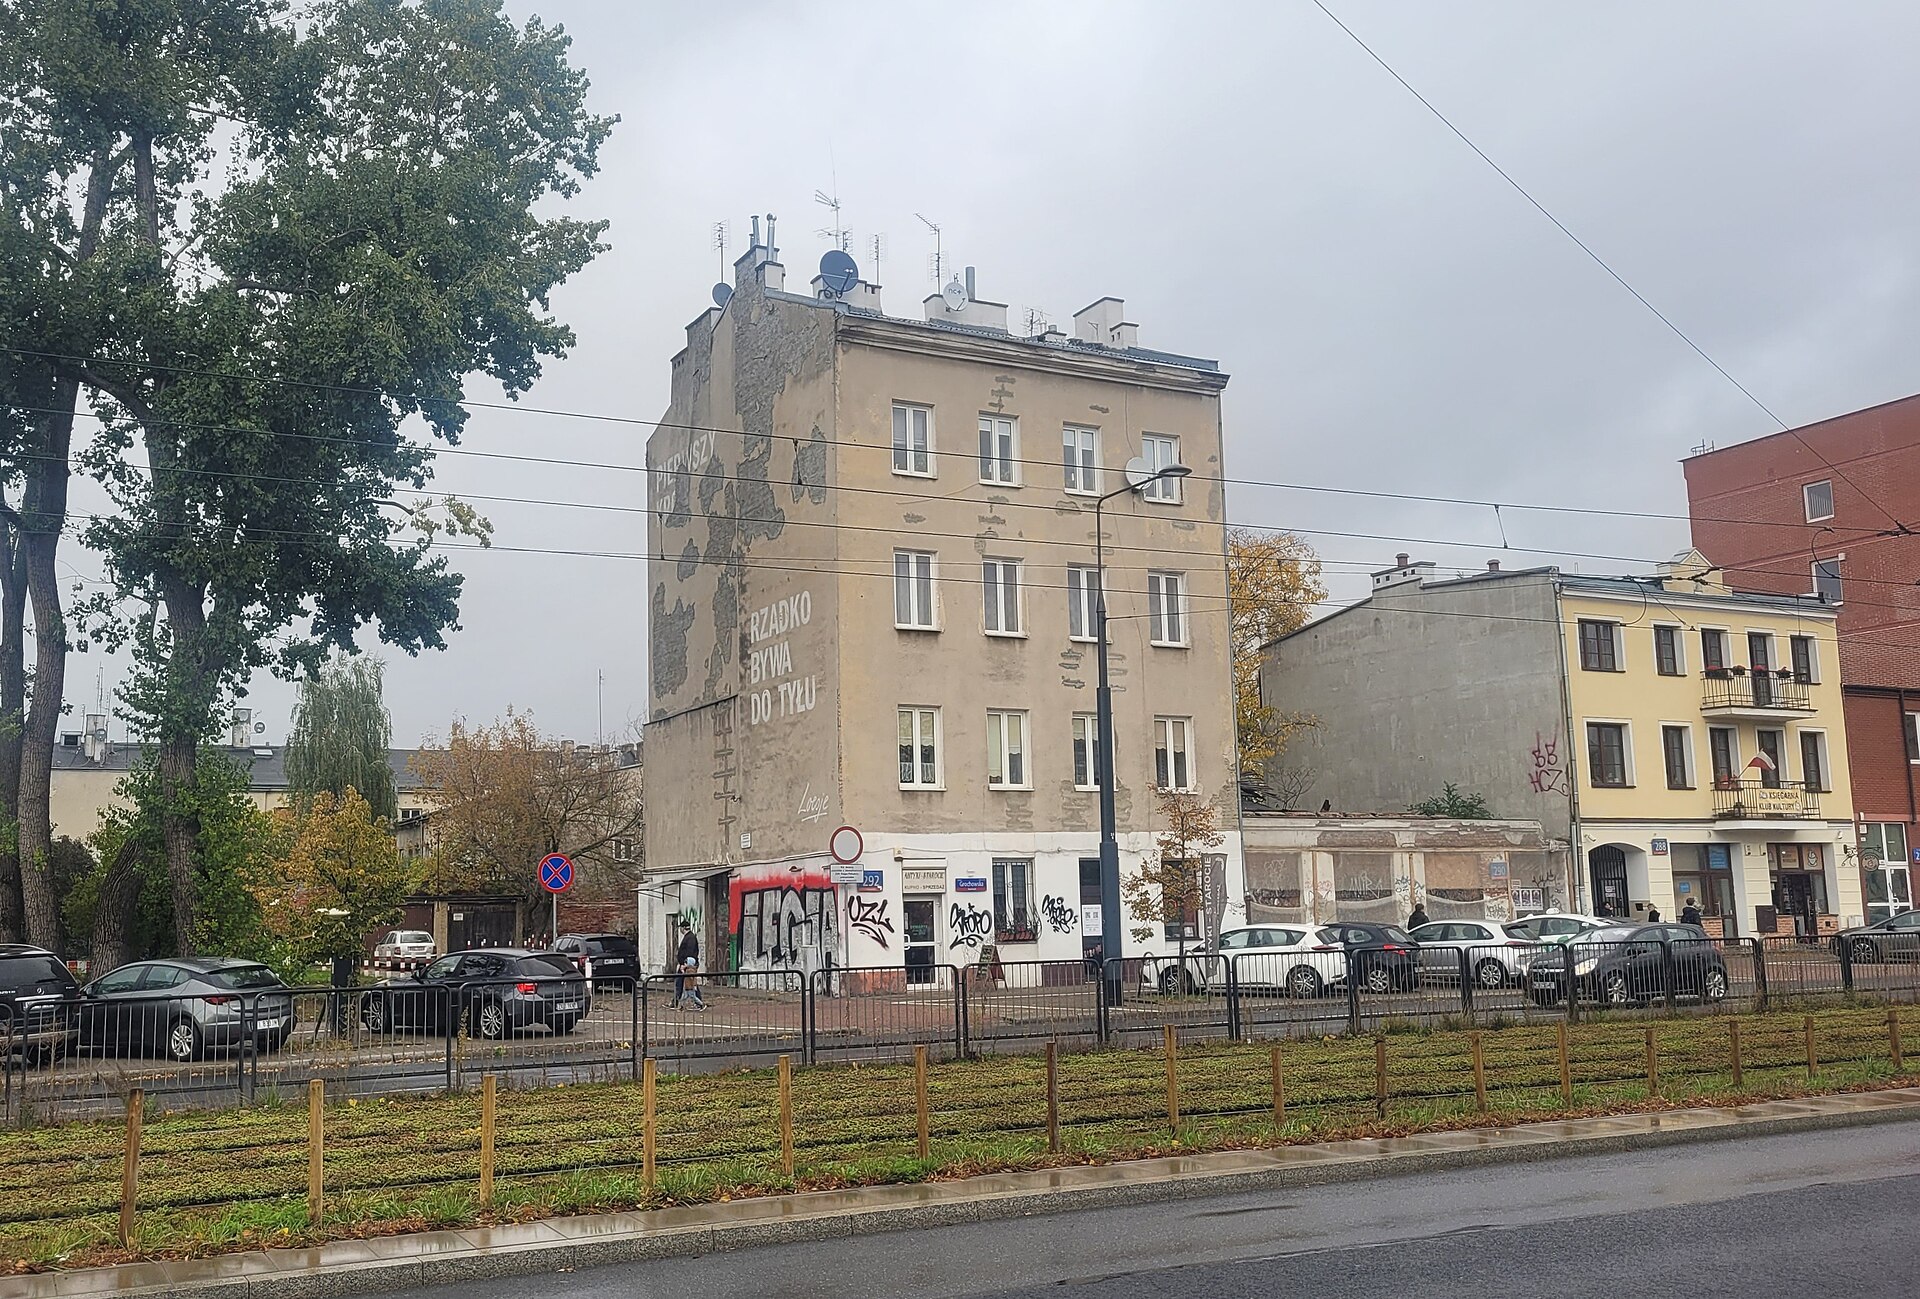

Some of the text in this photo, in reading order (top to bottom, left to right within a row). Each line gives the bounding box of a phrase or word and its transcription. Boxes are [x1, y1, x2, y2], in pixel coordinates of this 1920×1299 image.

[750, 590, 812, 643] RZADKO
[750, 641, 792, 684] BYWA
[751, 675, 816, 725] DO TYŁU
[1654, 841, 1667, 851] 288
[863, 875, 880, 887] 292
[1204, 856, 1213, 915] STAROCIE
